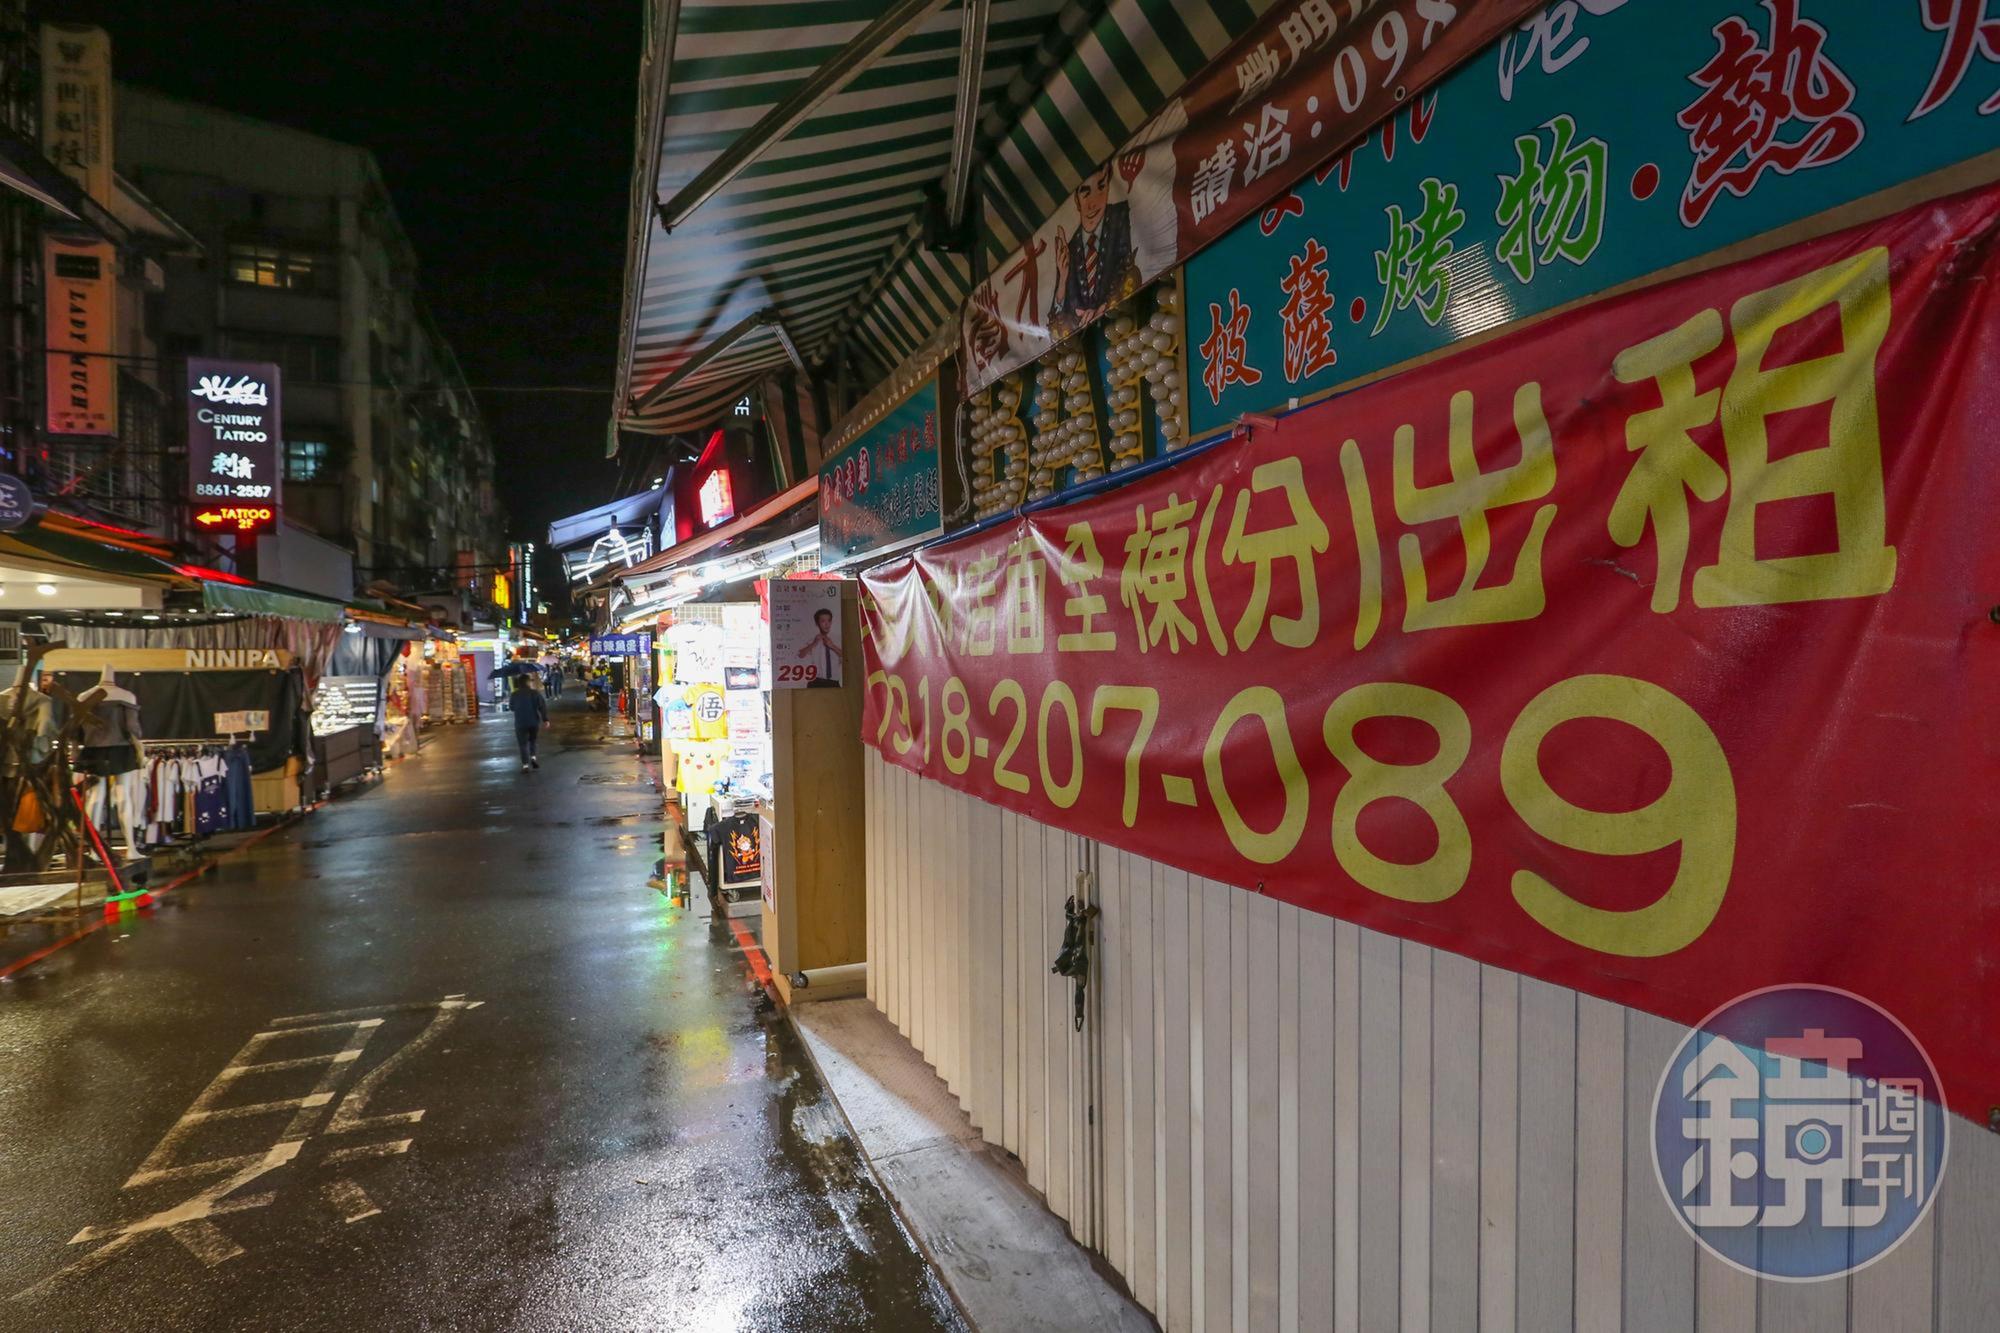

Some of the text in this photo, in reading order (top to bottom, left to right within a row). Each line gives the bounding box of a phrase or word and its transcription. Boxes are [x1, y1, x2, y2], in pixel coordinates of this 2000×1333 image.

[69, 289, 88, 410] LADY MUCH
[197, 409, 262, 426] CENTURY
[213, 426, 267, 442] TATTOO
[196, 484, 271, 498] 8861-2587
[220, 508, 271, 520] TATTOO
[238, 519, 254, 529] 2F
[185, 649, 280, 669] NINIPA
[777, 664, 818, 682] 299
[698, 697, 722, 719] 悟
